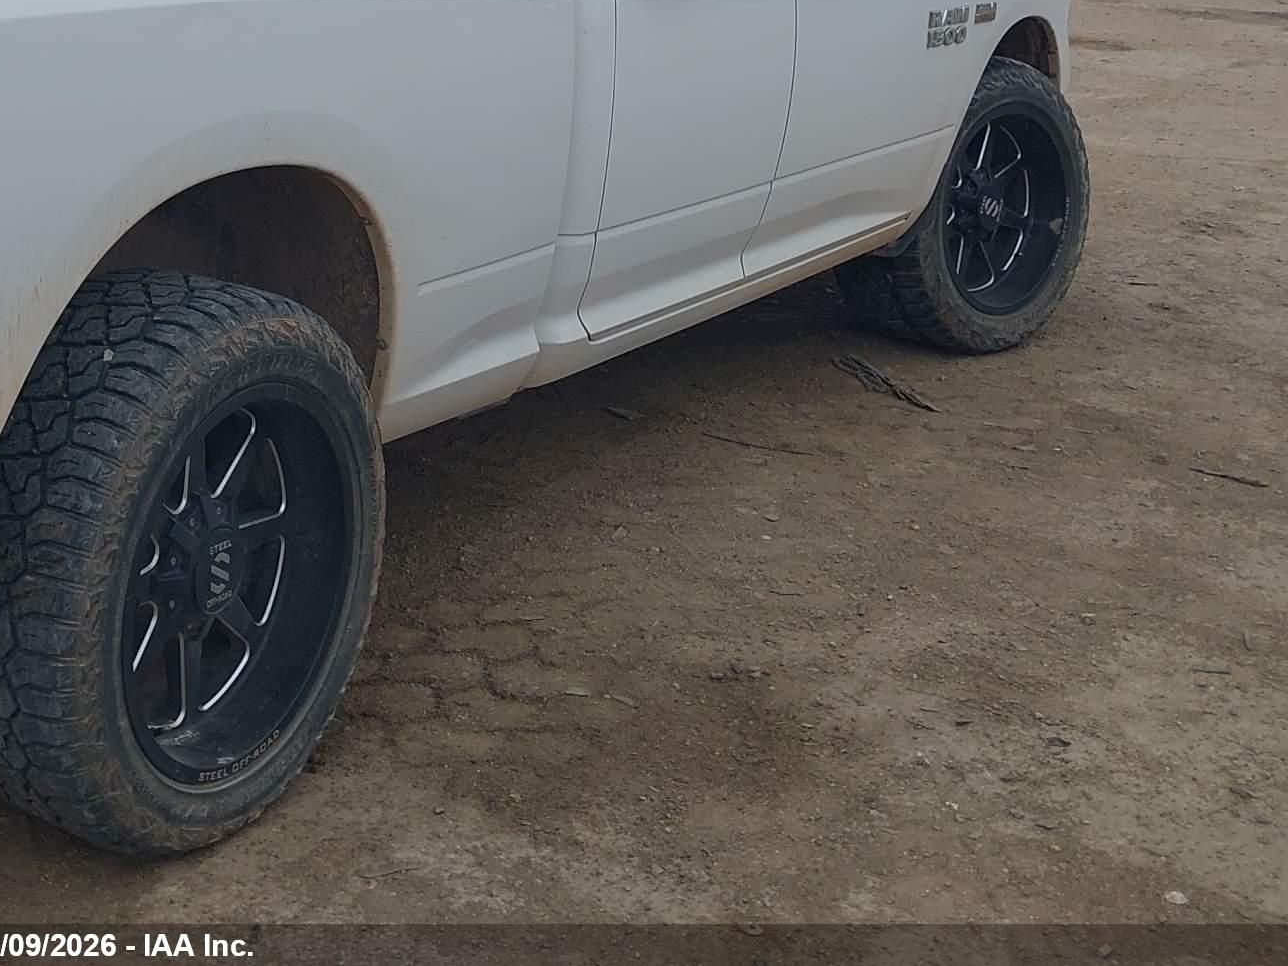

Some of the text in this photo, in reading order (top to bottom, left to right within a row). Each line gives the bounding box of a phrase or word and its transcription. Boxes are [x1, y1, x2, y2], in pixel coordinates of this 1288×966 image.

[927, 6, 970, 29] RAM
[926, 25, 968, 50] 1500
[209, 539, 233, 555] STEEL
[198, 768, 230, 783] STEEL
[231, 729, 281, 773] OFF-ROAD
